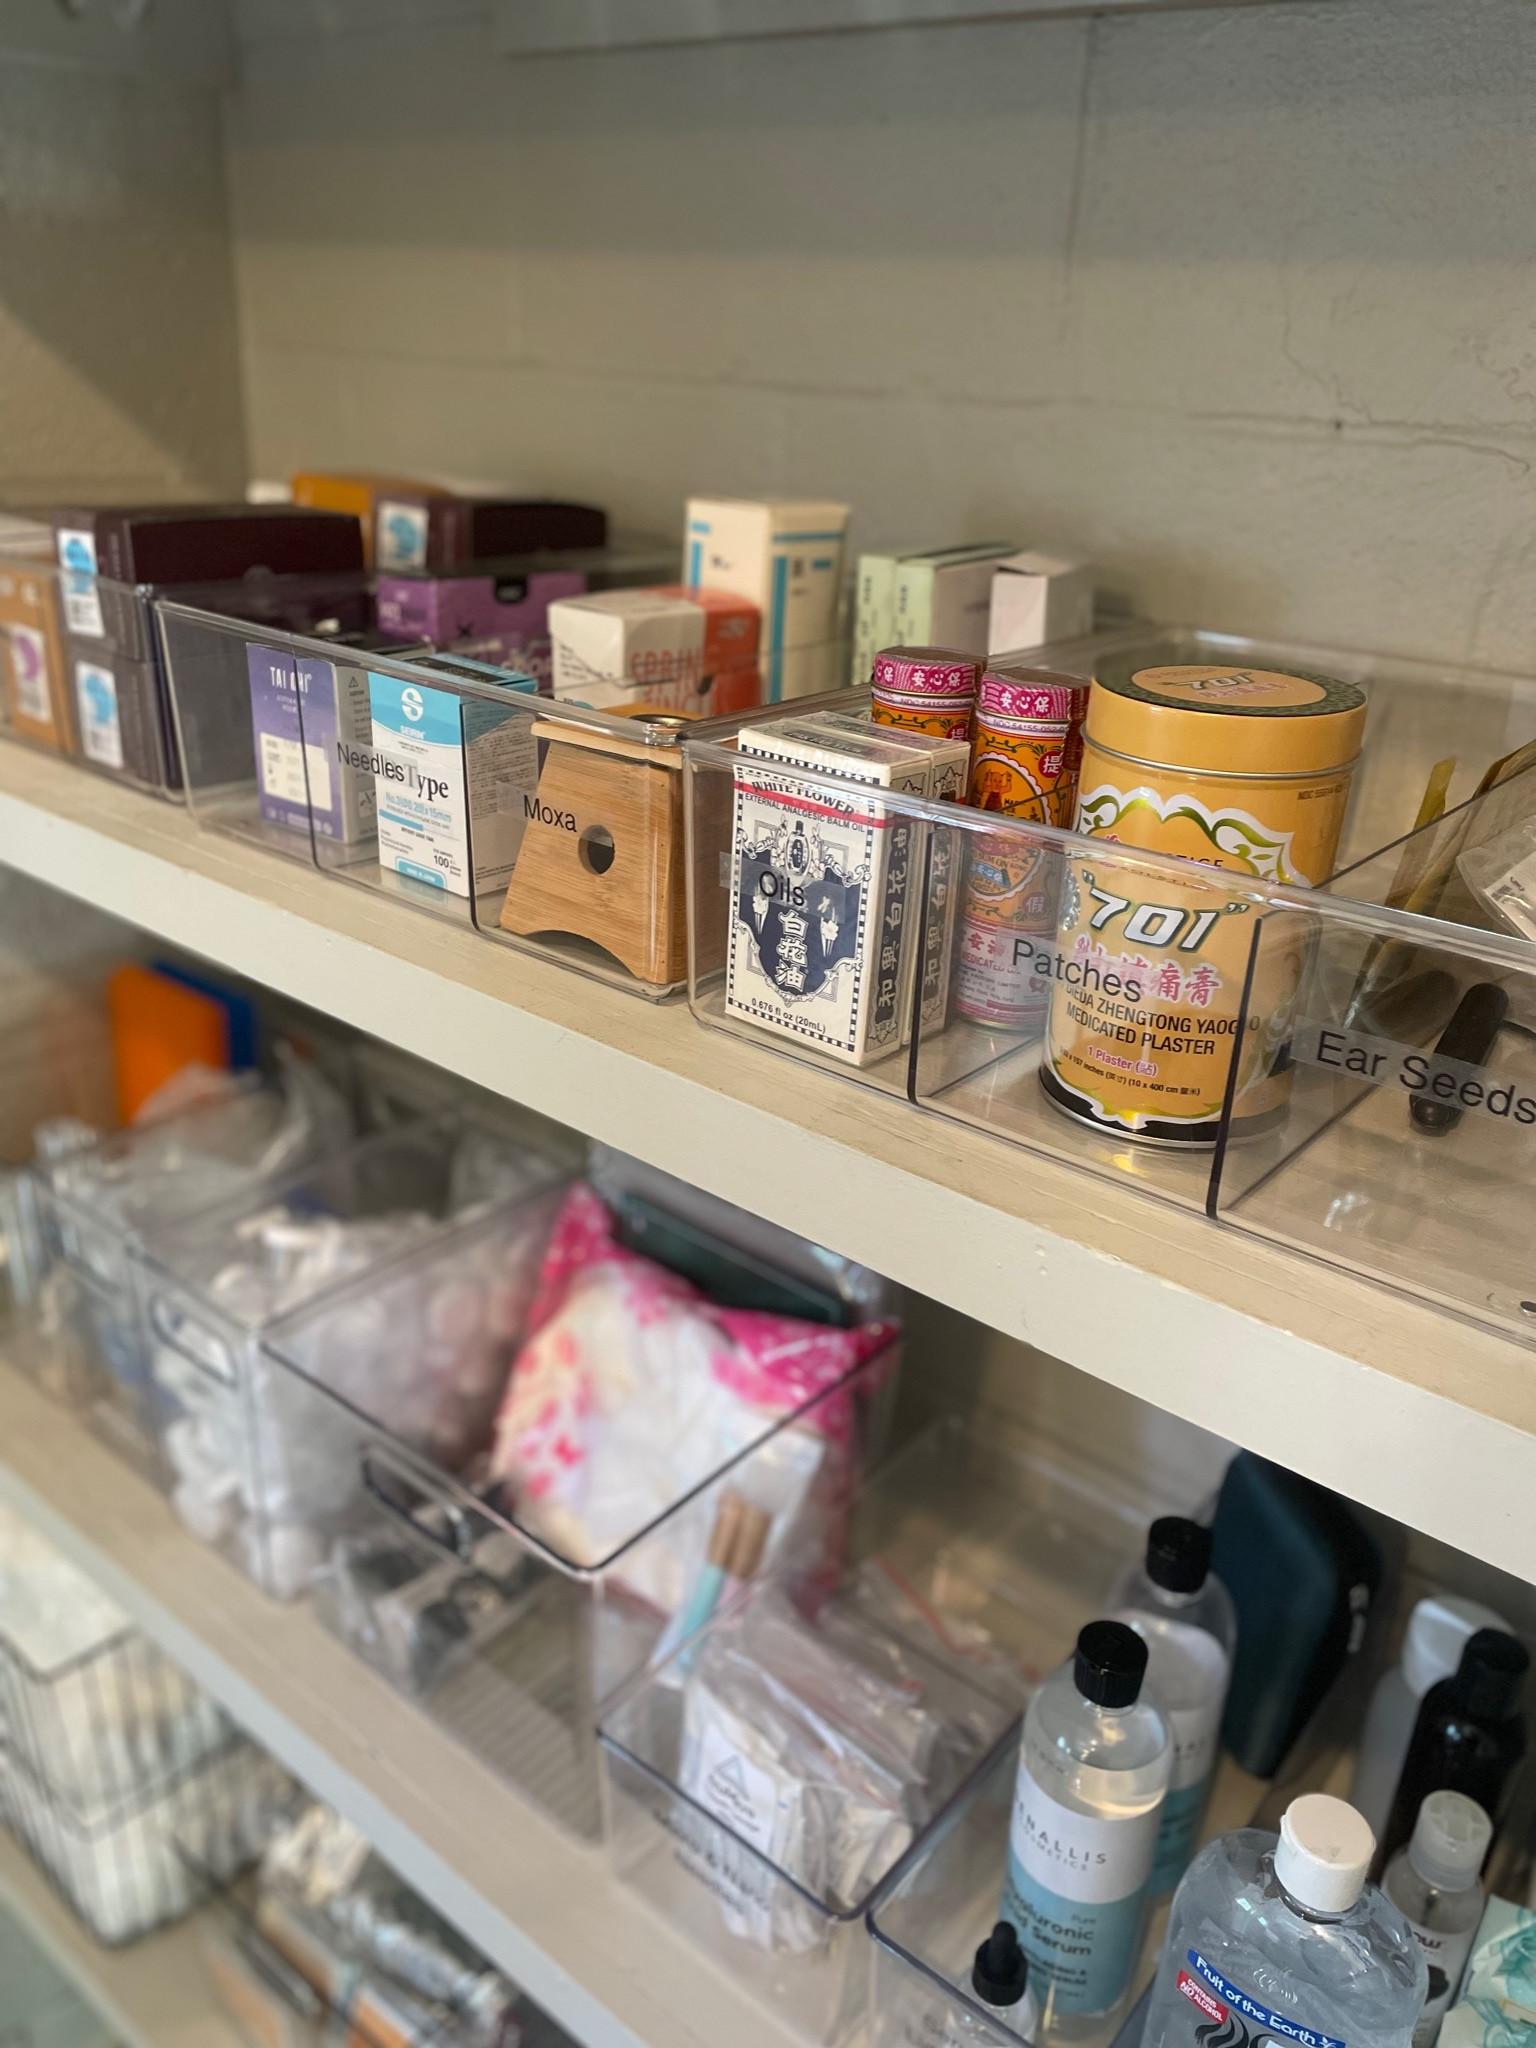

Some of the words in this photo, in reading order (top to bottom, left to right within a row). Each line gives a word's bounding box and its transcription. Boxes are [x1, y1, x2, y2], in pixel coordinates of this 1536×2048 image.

[270, 667, 287, 689] TAI
[336, 741, 405, 782] Needles
[523, 794, 578, 833] Moxa
[745, 792, 781, 810] EXTERNAL
[782, 803, 825, 823] ANALGESIC
[827, 815, 851, 830] BALM
[851, 823, 866, 834] OIL
[752, 780, 794, 795] WHITE
[797, 786, 856, 818] FLOWER
[433, 854, 450, 869] 100
[759, 870, 805, 907] Oils
[1012, 937, 1142, 1003] Patches
[752, 998, 774, 1014] 0.676
[783, 1011, 794, 1021] oz
[795, 1014, 827, 1035] (20mL)
[1066, 1001, 1137, 1045] MEDICATED
[1140, 1032, 1216, 1056] PLASTER
[1097, 997, 1192, 1033] ZHENGTONG
[1196, 1015, 1261, 1036] YAOGO
[1095, 1049, 1133, 1071] Plaster
[1316, 1029, 1388, 1077] Ear
[1399, 1055, 1536, 1125] Seeds
[1149, 1082, 1165, 1093] 400
[1165, 1085, 1179, 1095] cm
[1178, 1980, 1195, 1997] NO
[1193, 1989, 1224, 2022] ALCOHOL
[1186, 1977, 1218, 2009] CONTAINS
[1196, 1956, 1225, 1988] Fruit
[1225, 1988, 1243, 2005] of
[1242, 1998, 1267, 2022] the
[1268, 2014, 1317, 2047] Earth
